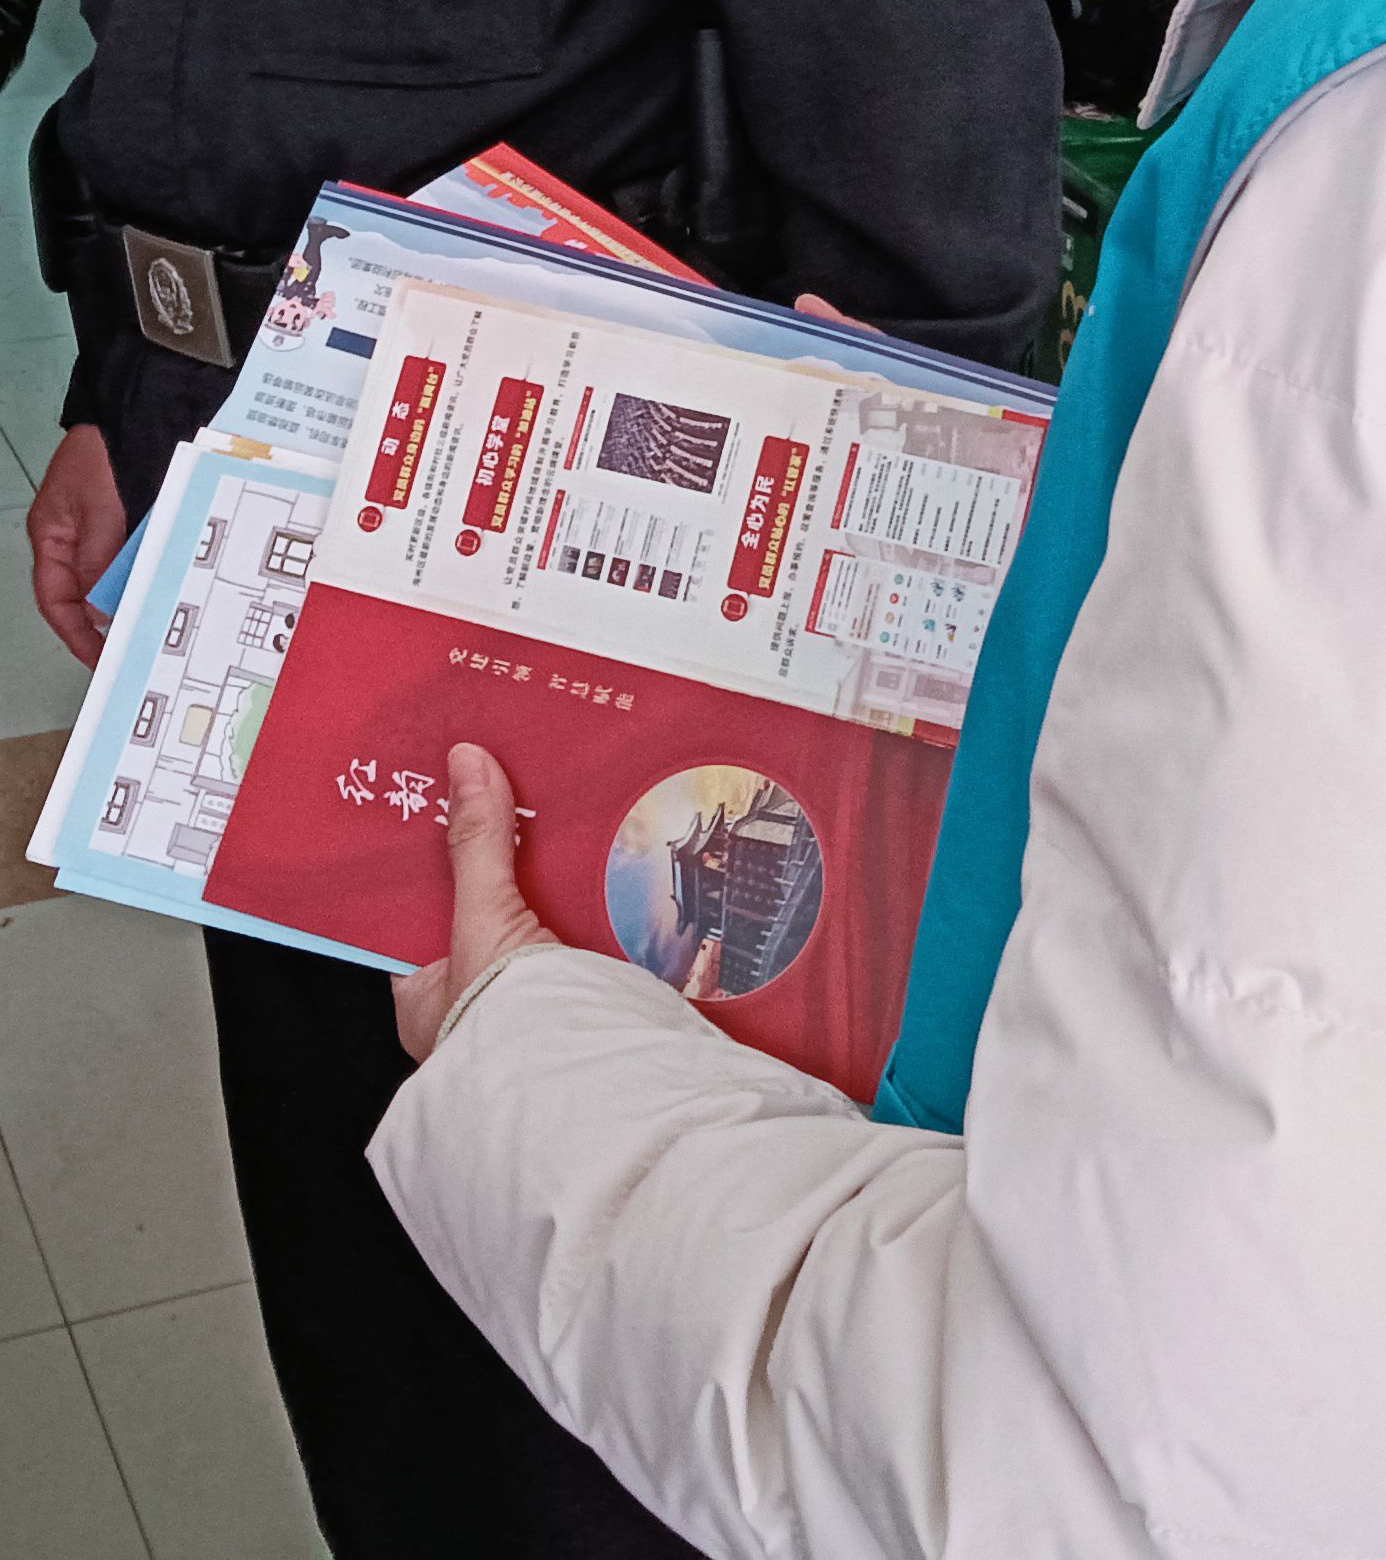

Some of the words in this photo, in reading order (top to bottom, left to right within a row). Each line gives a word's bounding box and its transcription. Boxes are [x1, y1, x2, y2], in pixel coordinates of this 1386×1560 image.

[380, 399, 411, 457] 动态
[474, 413, 511, 486] 初心学堂
[738, 473, 775, 550] 全心为民
[449, 648, 533, 682] 党建引领
